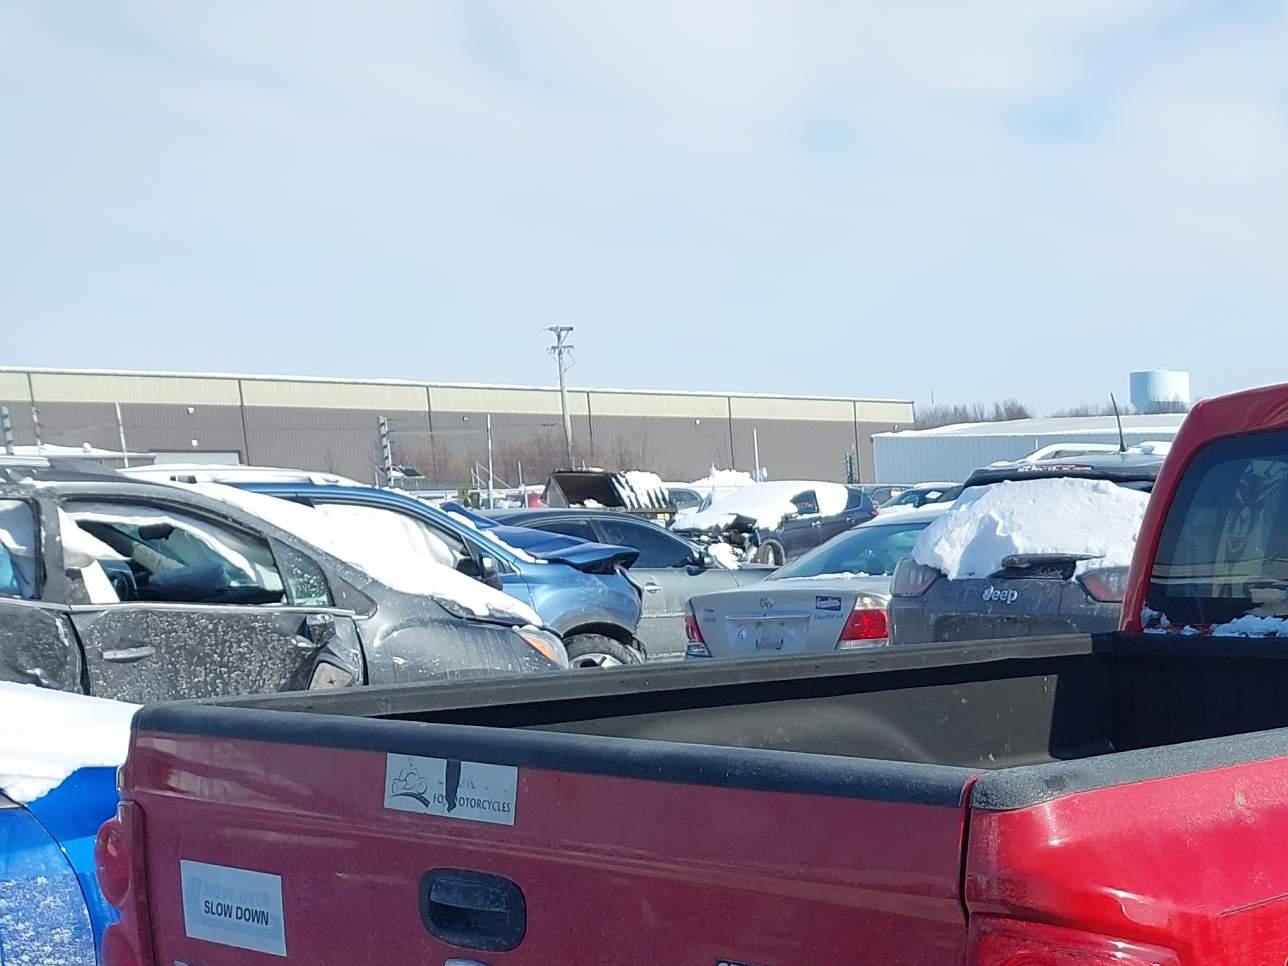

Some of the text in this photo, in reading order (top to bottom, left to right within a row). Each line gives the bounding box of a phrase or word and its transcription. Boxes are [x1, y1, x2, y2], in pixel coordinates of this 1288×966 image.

[982, 584, 1018, 605] Jeep
[456, 795, 511, 813] OTORCYCLES
[203, 899, 270, 926] SLOW DOWN
